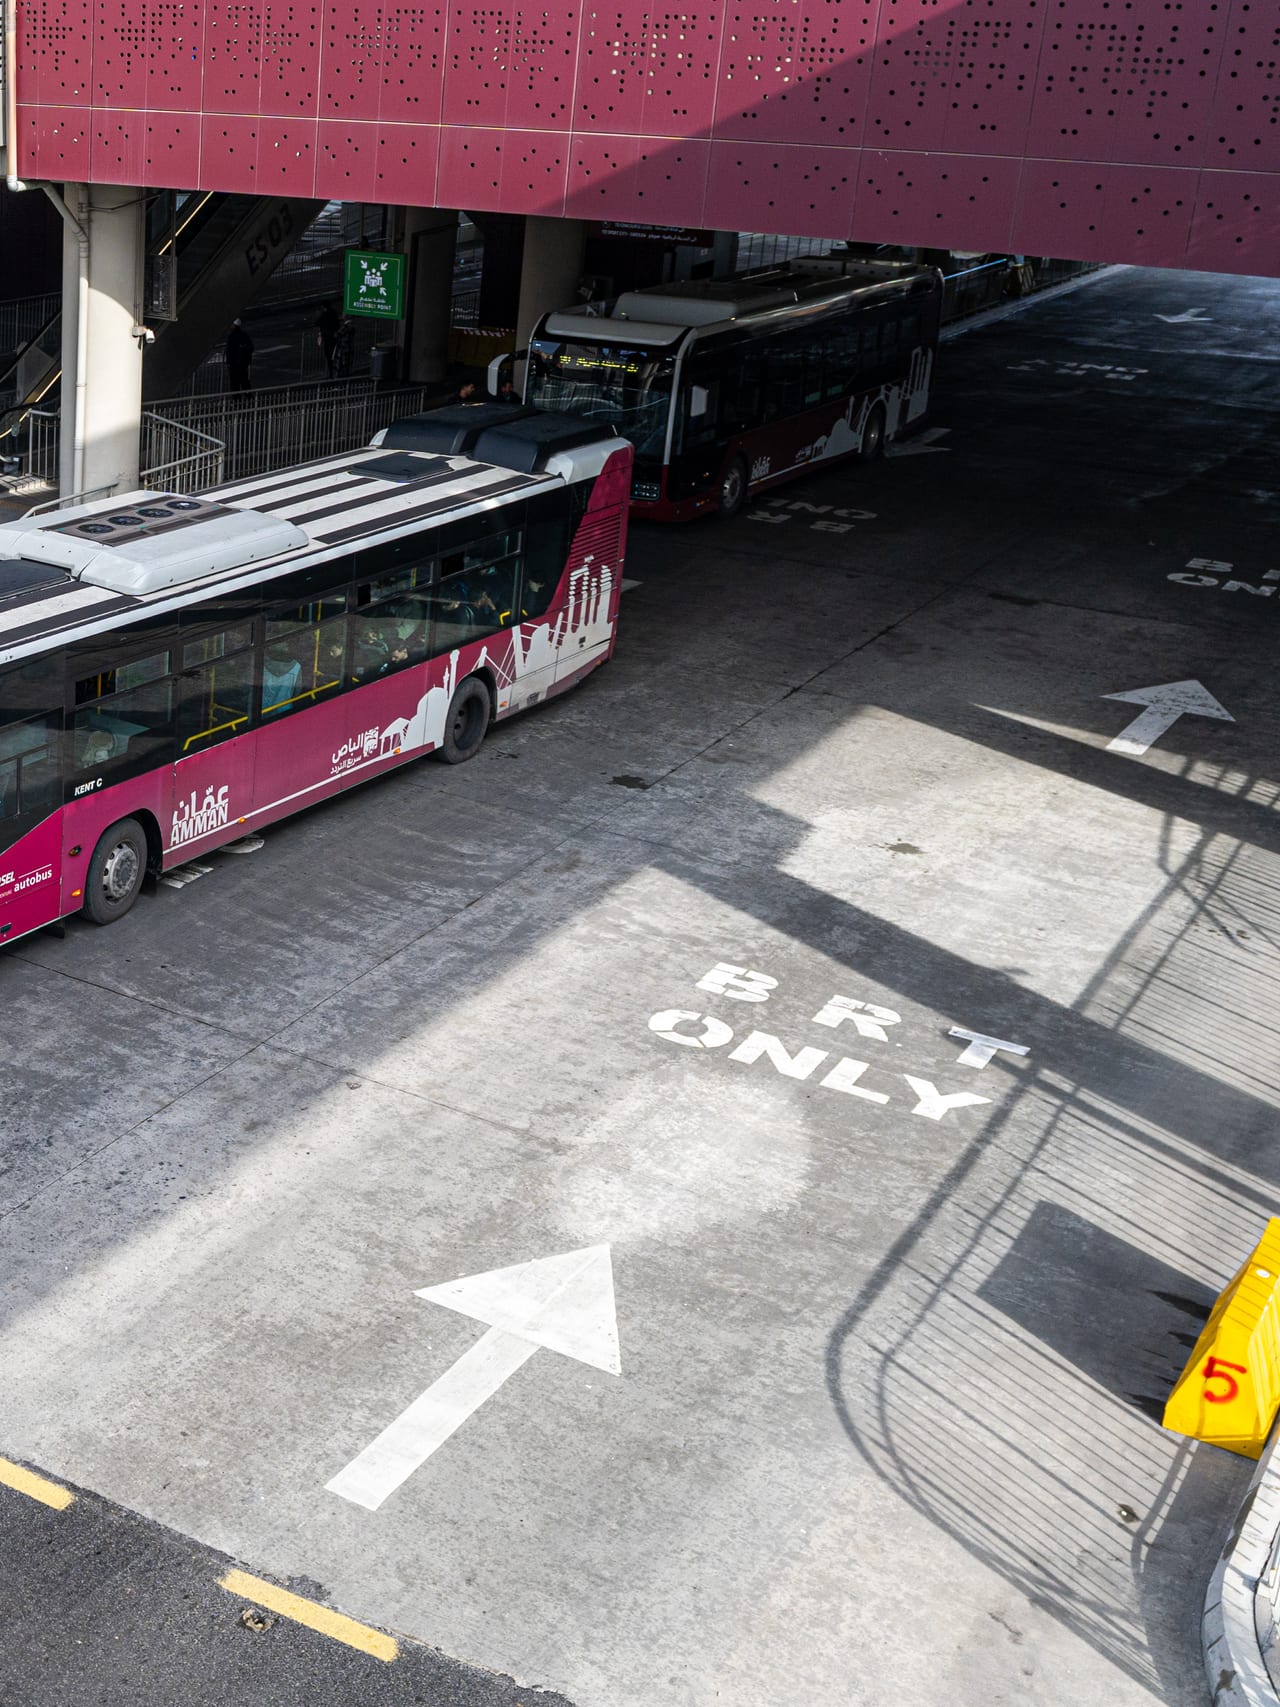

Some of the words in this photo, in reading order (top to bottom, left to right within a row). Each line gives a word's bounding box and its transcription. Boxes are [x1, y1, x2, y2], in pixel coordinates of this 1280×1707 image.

[332, 733, 364, 764] الباص
[74, 780, 96, 796] KENT
[96, 778, 103, 787] C
[170, 803, 229, 846] AMMAN
[14, 869, 53, 892] autobus
[648, 1009, 993, 1120] ONLY
[1203, 1356, 1247, 1404] 5
